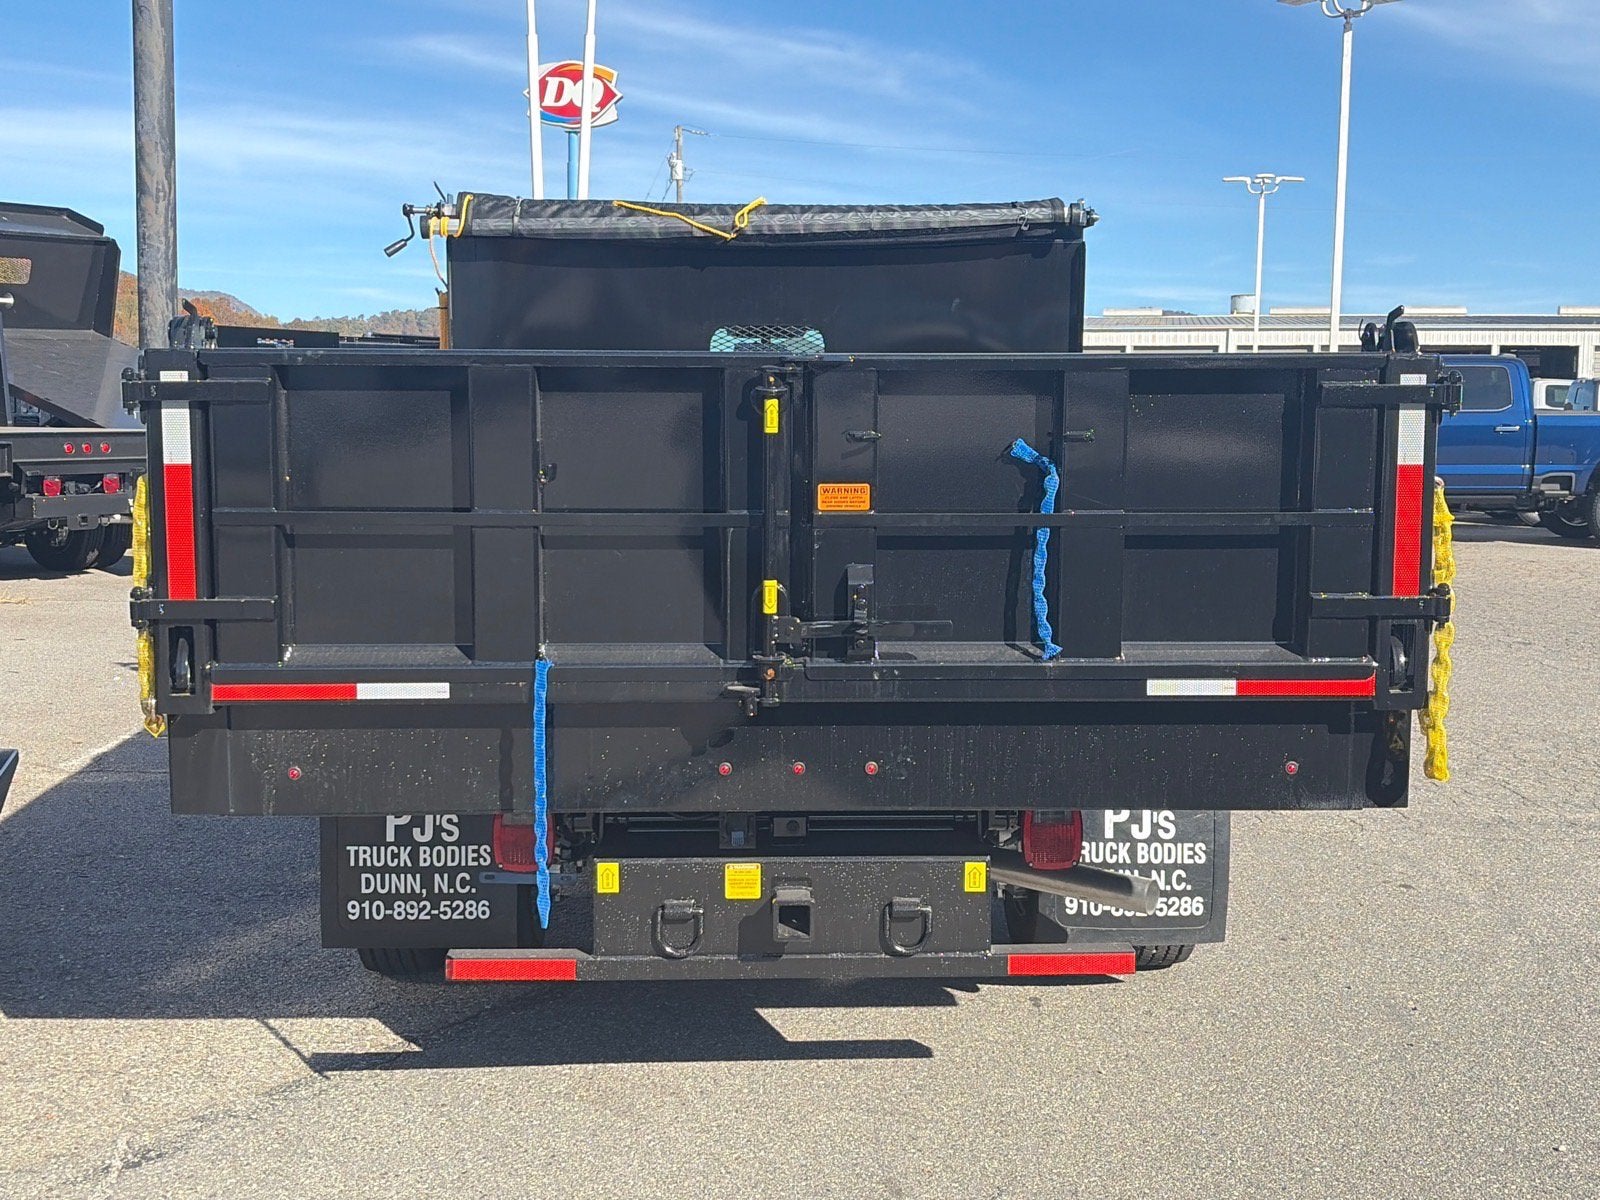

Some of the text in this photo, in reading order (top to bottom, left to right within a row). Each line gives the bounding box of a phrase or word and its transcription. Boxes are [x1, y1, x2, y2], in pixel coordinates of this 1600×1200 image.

[541, 76, 605, 112] DQ
[386, 814, 460, 842] PJ'S
[1104, 809, 1176, 839] PJ'S
[346, 844, 491, 867] TRUCK BODIES
[1080, 841, 1207, 864] RUCK BODIES
[360, 872, 477, 898] DUNN, N.C.
[1151, 869, 1192, 891] N.C.
[346, 900, 491, 921] 910-892-5286
[1064, 896, 1204, 917] 910-5286
